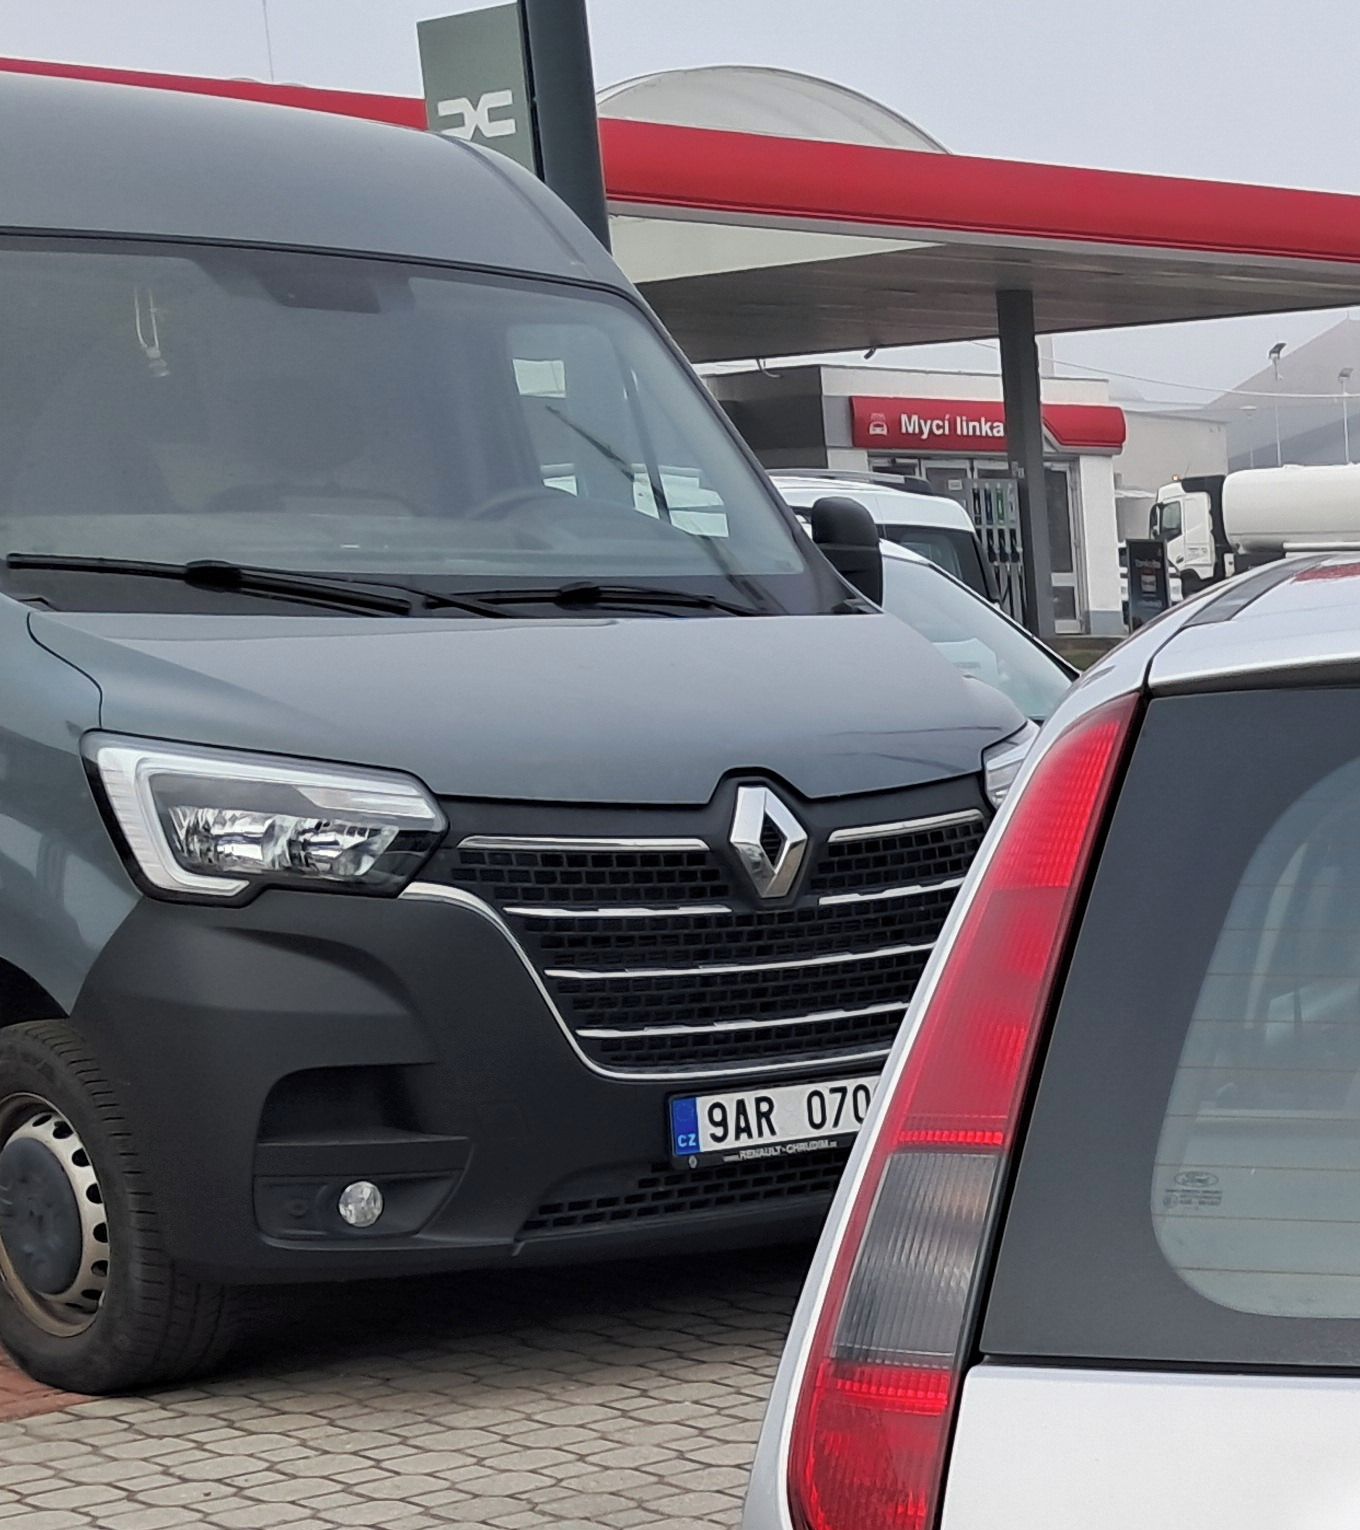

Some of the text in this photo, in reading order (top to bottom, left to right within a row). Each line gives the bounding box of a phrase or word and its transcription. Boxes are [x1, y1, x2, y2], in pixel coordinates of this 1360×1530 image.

[900, 413, 1005, 440] Mycí linka
[706, 1082, 880, 1144] 9AR 070
[677, 1132, 697, 1148] CZ
